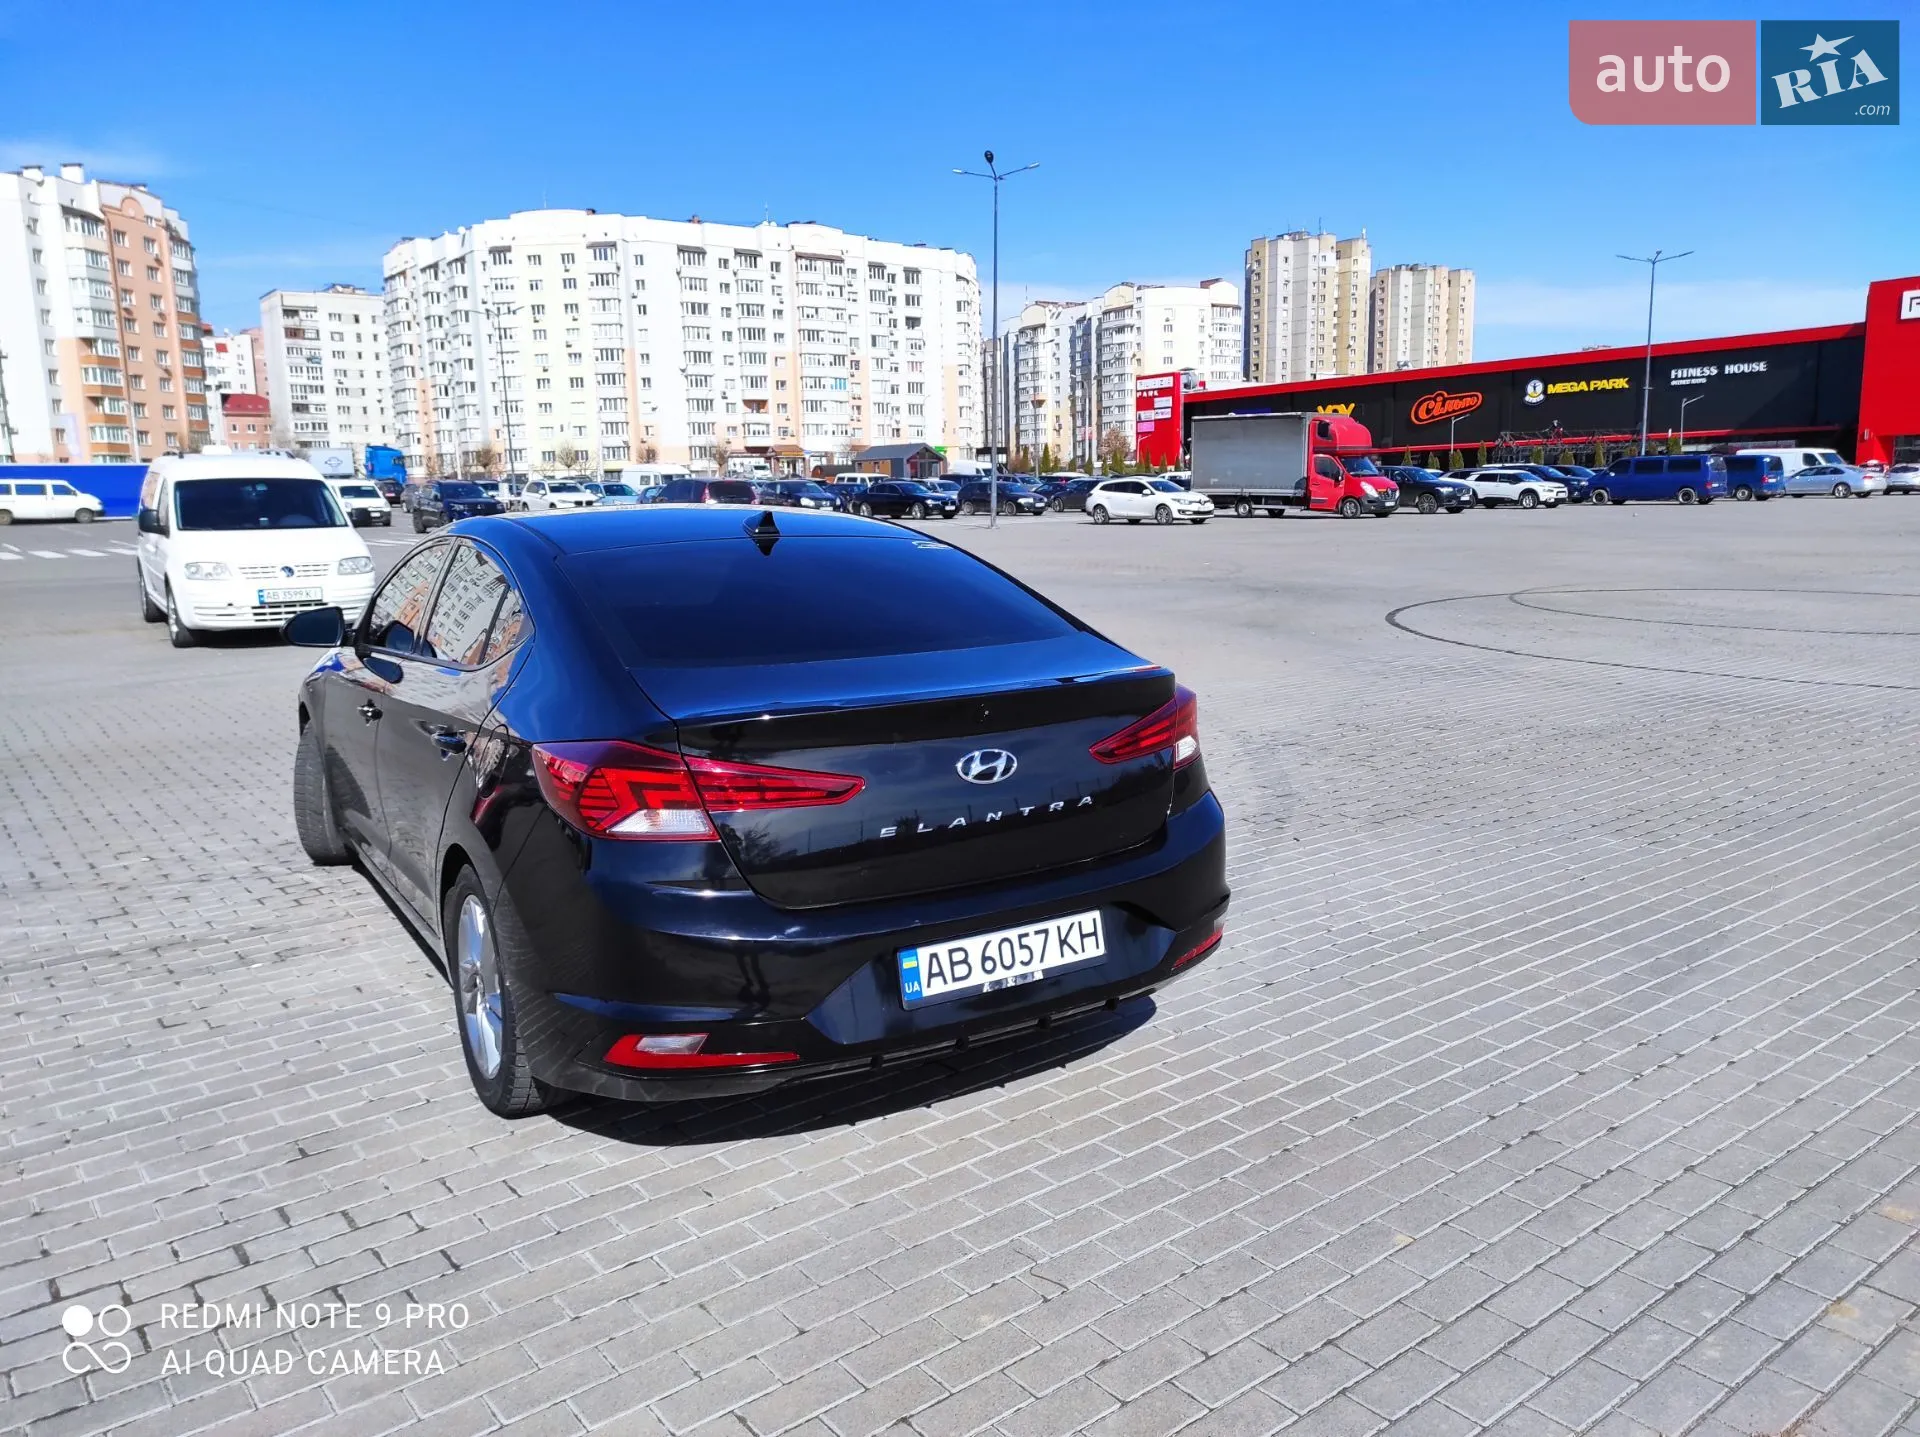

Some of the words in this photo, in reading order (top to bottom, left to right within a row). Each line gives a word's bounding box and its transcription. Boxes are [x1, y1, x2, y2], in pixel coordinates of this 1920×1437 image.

[1670, 366, 1718, 379] FITNESS
[1724, 361, 1767, 374] HOUSE
[1547, 381, 1588, 394] MEGA
[1589, 378, 1629, 391] PARK
[879, 796, 1094, 838] ELANTRA
[926, 946, 973, 989] AB
[980, 928, 1049, 975] 6057
[1057, 918, 1100, 958] KH
[905, 983, 921, 994] UA
